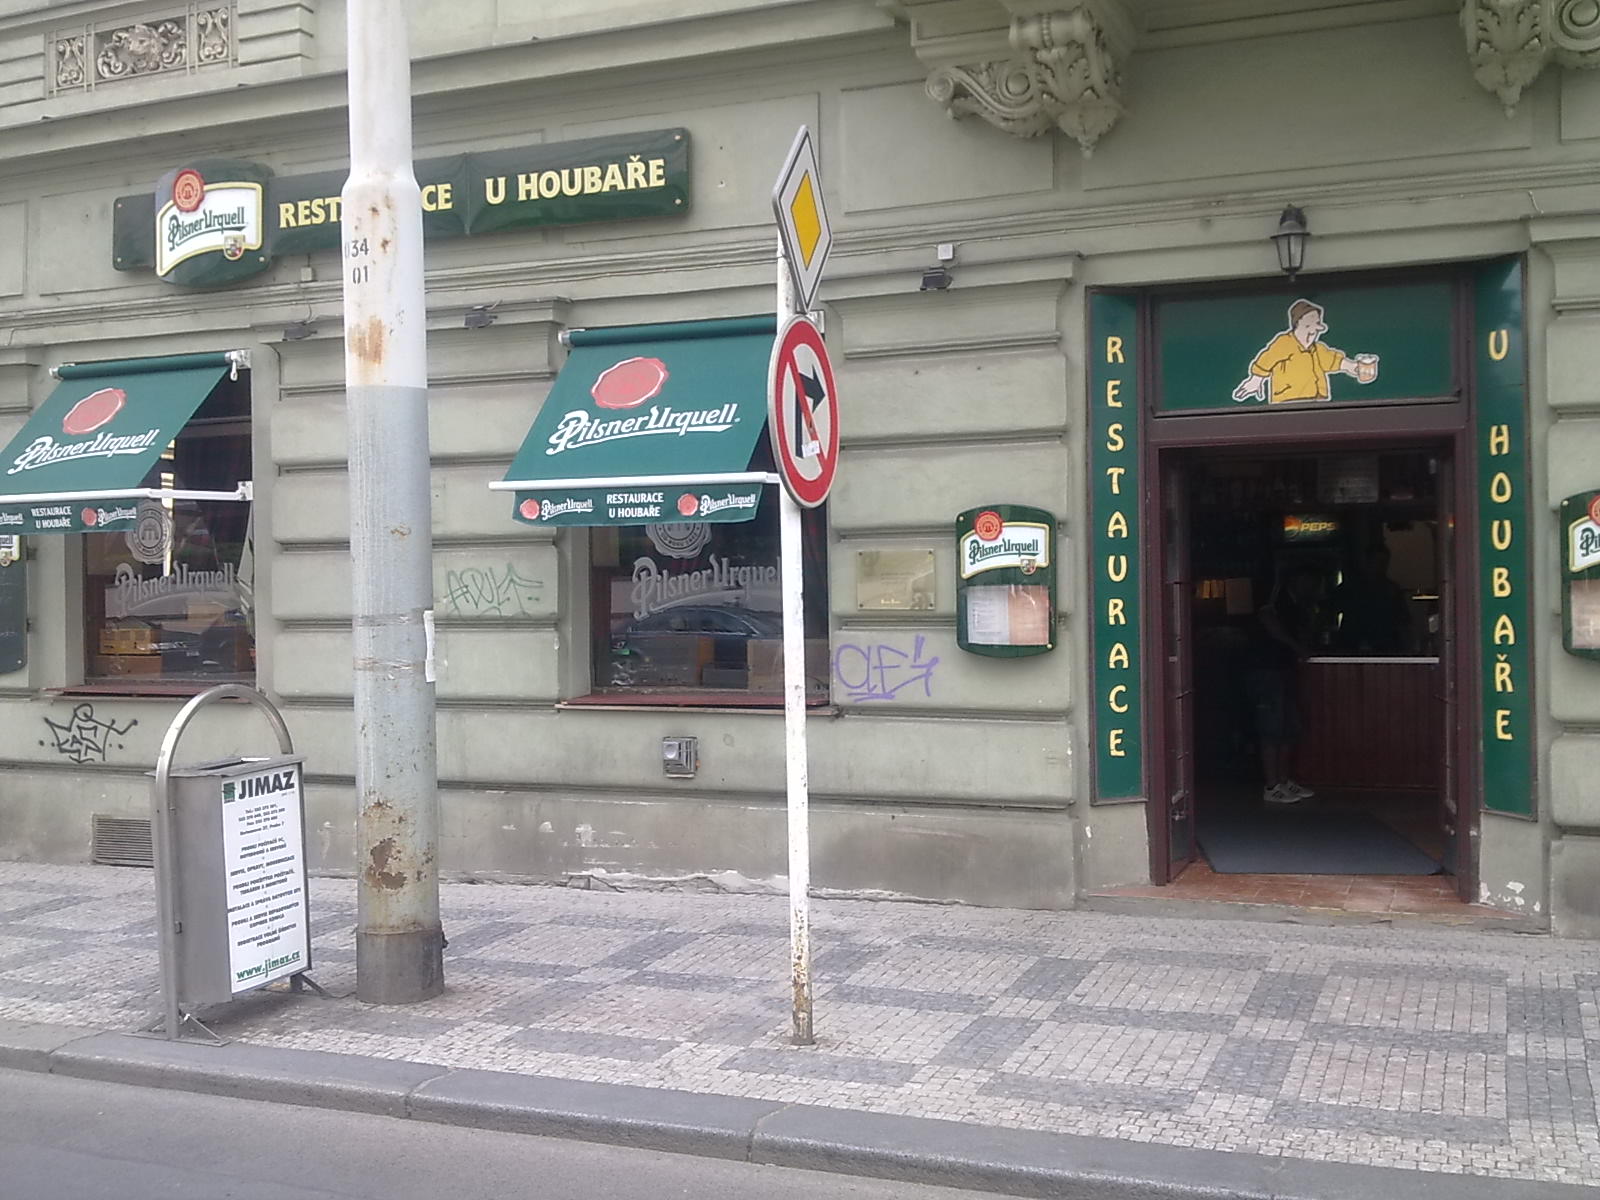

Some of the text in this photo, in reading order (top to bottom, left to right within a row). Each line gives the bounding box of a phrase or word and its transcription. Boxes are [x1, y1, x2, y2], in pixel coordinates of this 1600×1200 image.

[485, 177, 506, 205] U
[517, 155, 666, 201] HOUBAŘE
[168, 207, 245, 251] Pilsner Urquell
[352, 265, 368, 284] 01
[1488, 329, 1509, 360] U
[545, 403, 738, 455] Pilsner Urquell
[7, 429, 159, 475] Pilsner Urquell
[31, 506, 72, 517] RESTAURACE
[541, 498, 593, 520] Pilsner Urquell
[606, 492, 664, 505] RESTAURACE
[609, 507, 618, 518] U
[617, 505, 660, 518] HOUBAŘE
[700, 492, 756, 516] Pilsner Urquell
[35, 518, 42, 528] U
[42, 516, 72, 529] HOUBAŘE
[968, 537, 1039, 565] Pilsner Urquell
[1106, 336, 1130, 757] RESTAURACE
[114, 560, 235, 619] Pilsner Urquell
[631, 553, 782, 621] Pilsner Urquel
[1489, 424, 1516, 740] HOUBAŘE
[239, 771, 295, 799] JIMAZ
[236, 951, 301, 978] www.jimaz.cz
